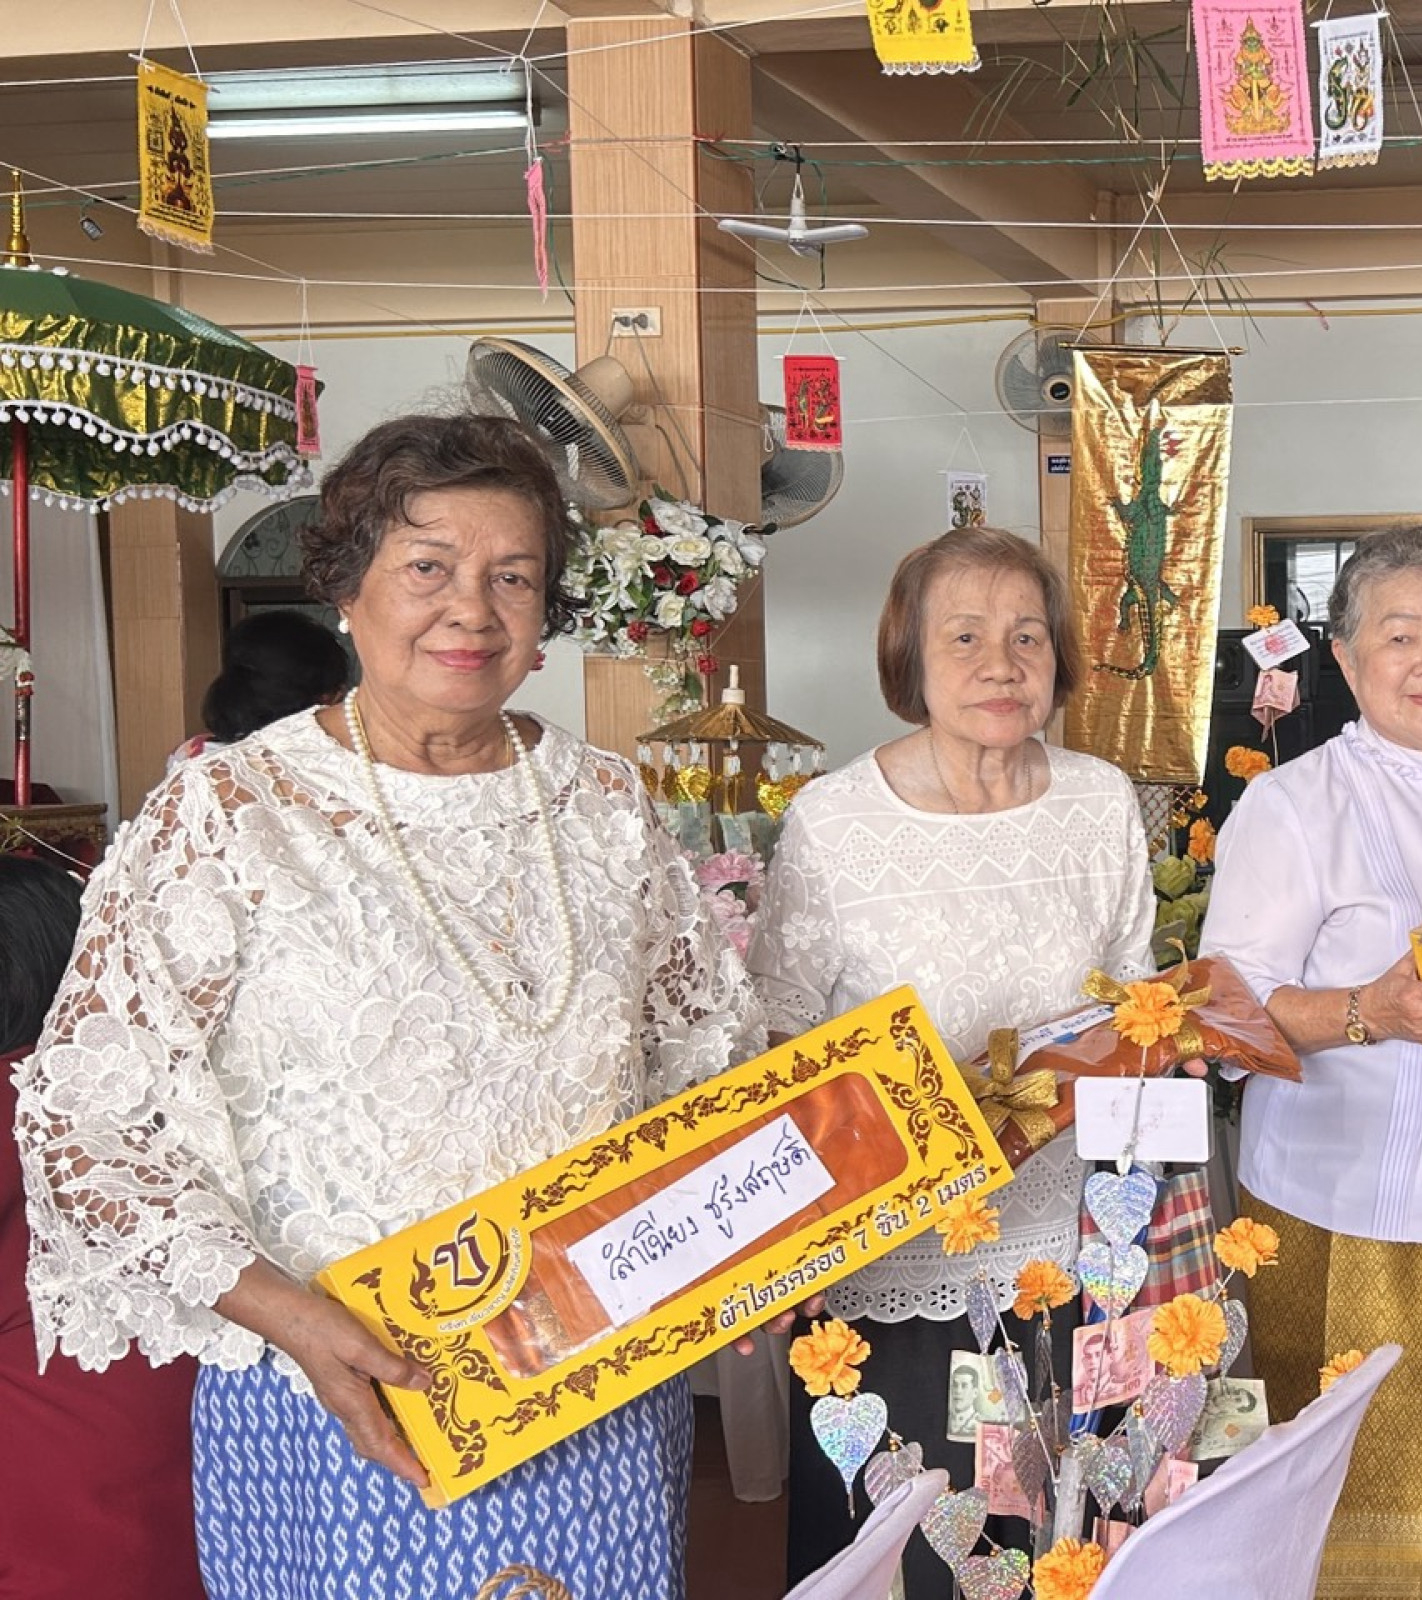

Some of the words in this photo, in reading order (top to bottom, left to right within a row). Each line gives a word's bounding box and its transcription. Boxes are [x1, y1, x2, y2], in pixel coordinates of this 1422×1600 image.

[718, 1245, 847, 1329] ผ้าไตรครอง
[852, 1228, 868, 1251] 7
[916, 1195, 933, 1217] 2
[936, 1164, 988, 1204] เมตร
